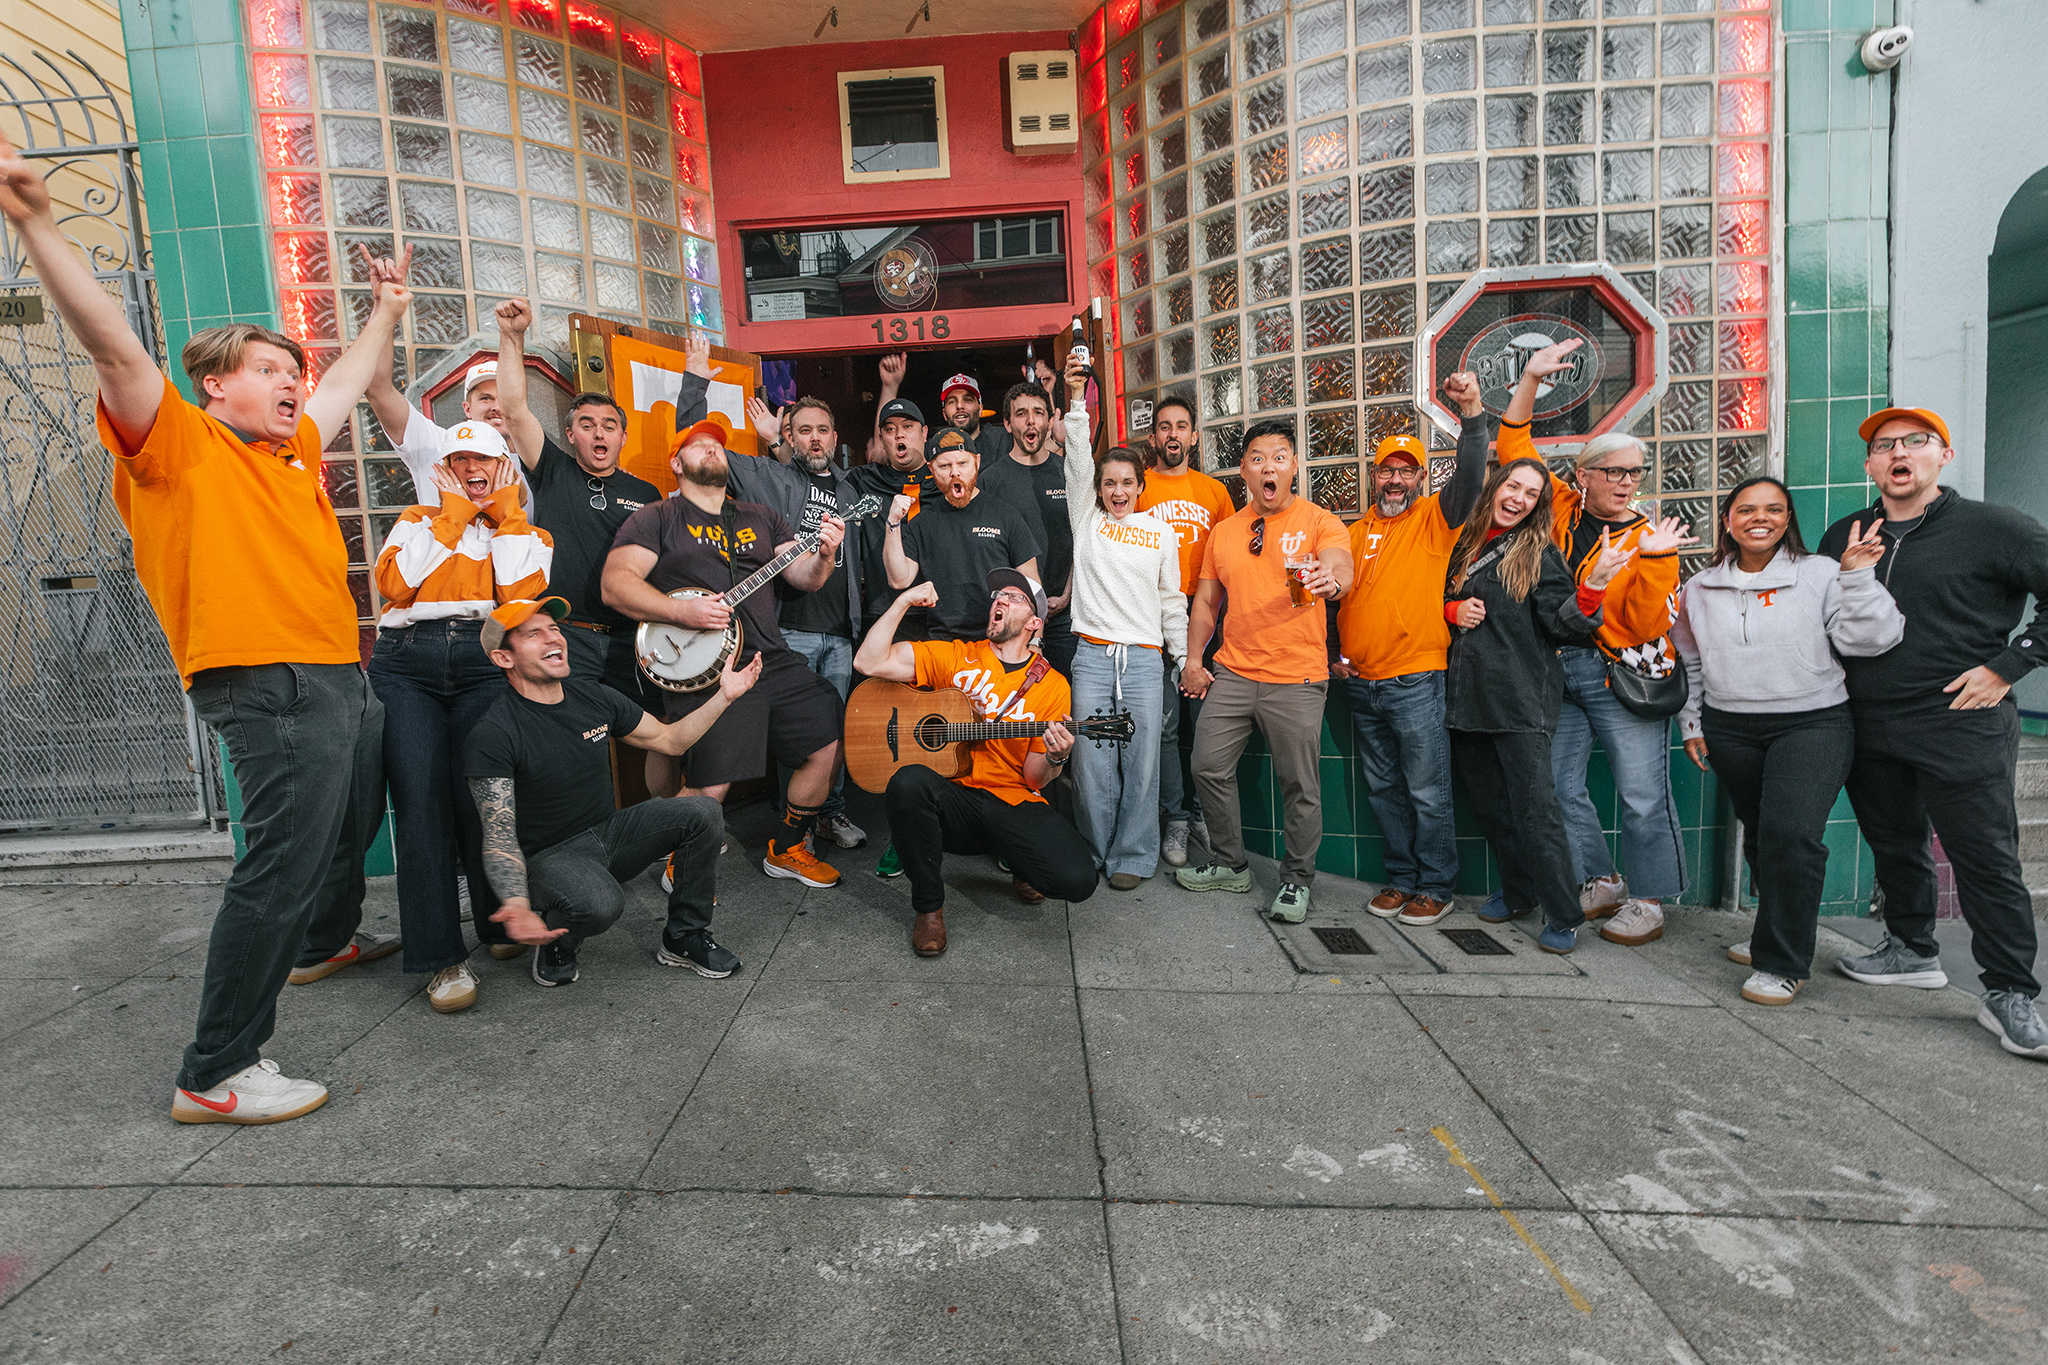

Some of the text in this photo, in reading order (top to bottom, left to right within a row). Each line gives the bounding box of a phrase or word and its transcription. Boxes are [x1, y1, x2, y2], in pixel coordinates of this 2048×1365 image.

[0, 301, 25, 318] 20
[871, 315, 950, 343] 1318
[1396, 437, 1410, 447] T
[907, 474, 916, 483] T
[1146, 500, 1210, 531] ENNESSEE
[1096, 516, 1160, 550] TENNESSEE
[1368, 534, 1383, 549] T
[697, 537, 754, 554] ATHLICS
[1757, 589, 1777, 607] T
